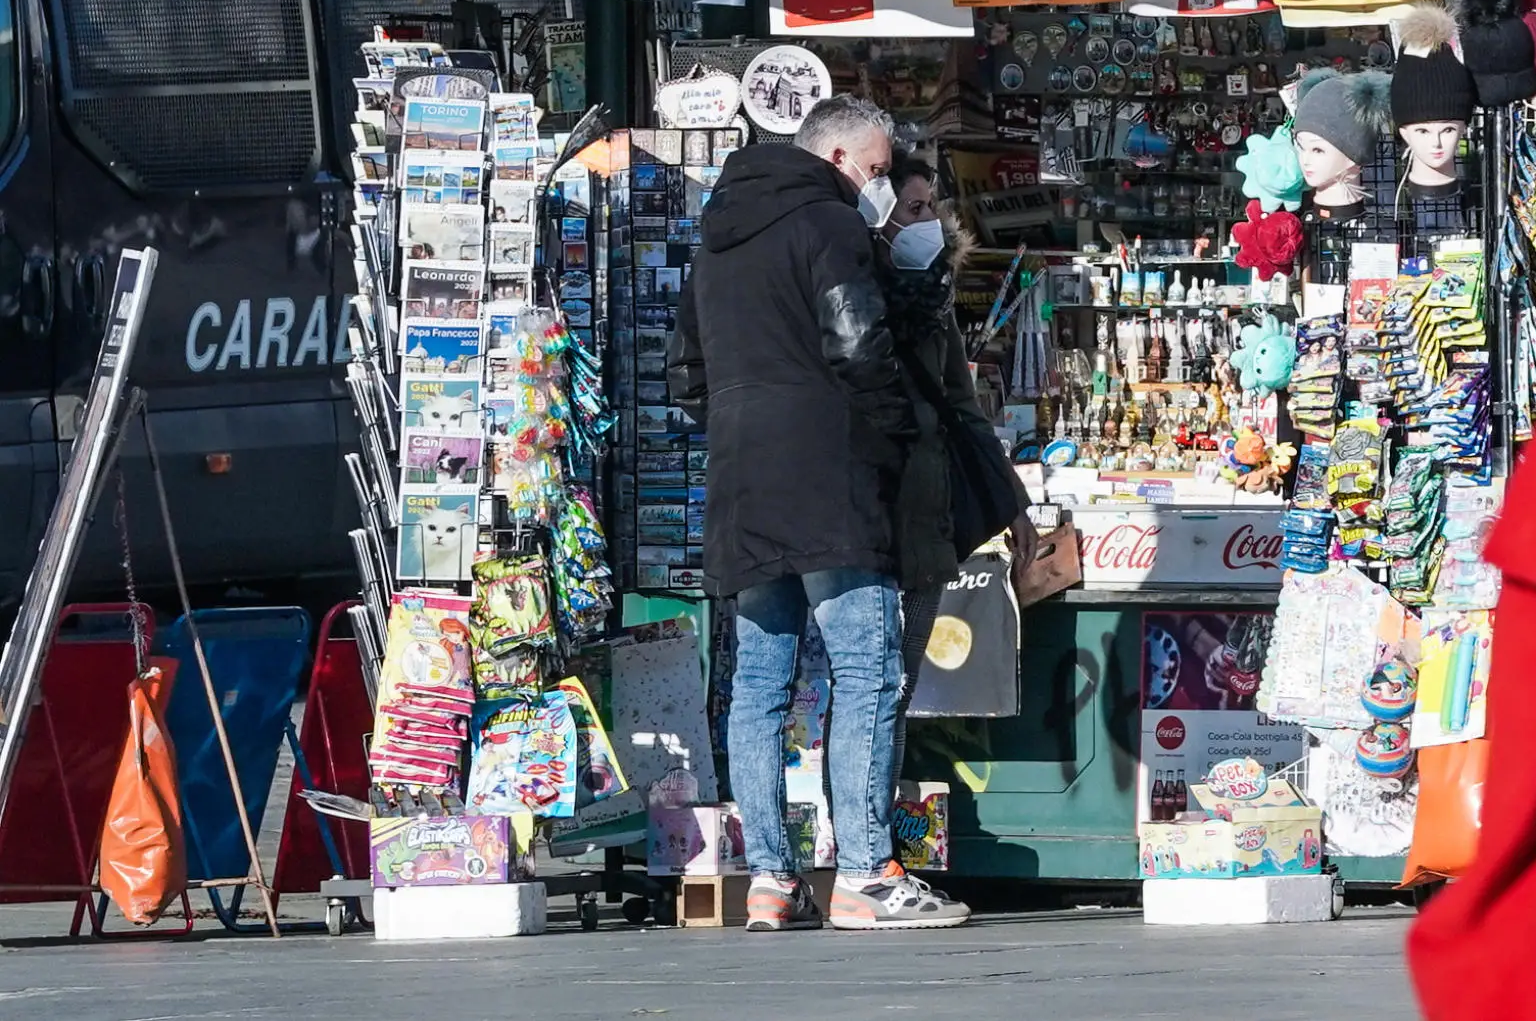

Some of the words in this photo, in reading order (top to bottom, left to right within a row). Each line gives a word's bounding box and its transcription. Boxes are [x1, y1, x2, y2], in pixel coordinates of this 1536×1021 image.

[422, 105, 469, 117] TORINO
[440, 215, 478, 228] Angeli
[413, 268, 477, 282] Leonardo
[408, 328, 431, 339] Papa
[432, 328, 479, 339] Francesco
[460, 339, 478, 347] 2022
[410, 382, 444, 393] Gatti
[412, 437, 442, 448] Cani
[407, 496, 440, 506] Gatti
[1207, 732, 1252, 741] Coca-Cola
[1254, 732, 1290, 742] bottiglia
[1207, 746, 1252, 756] Coca-Cola
